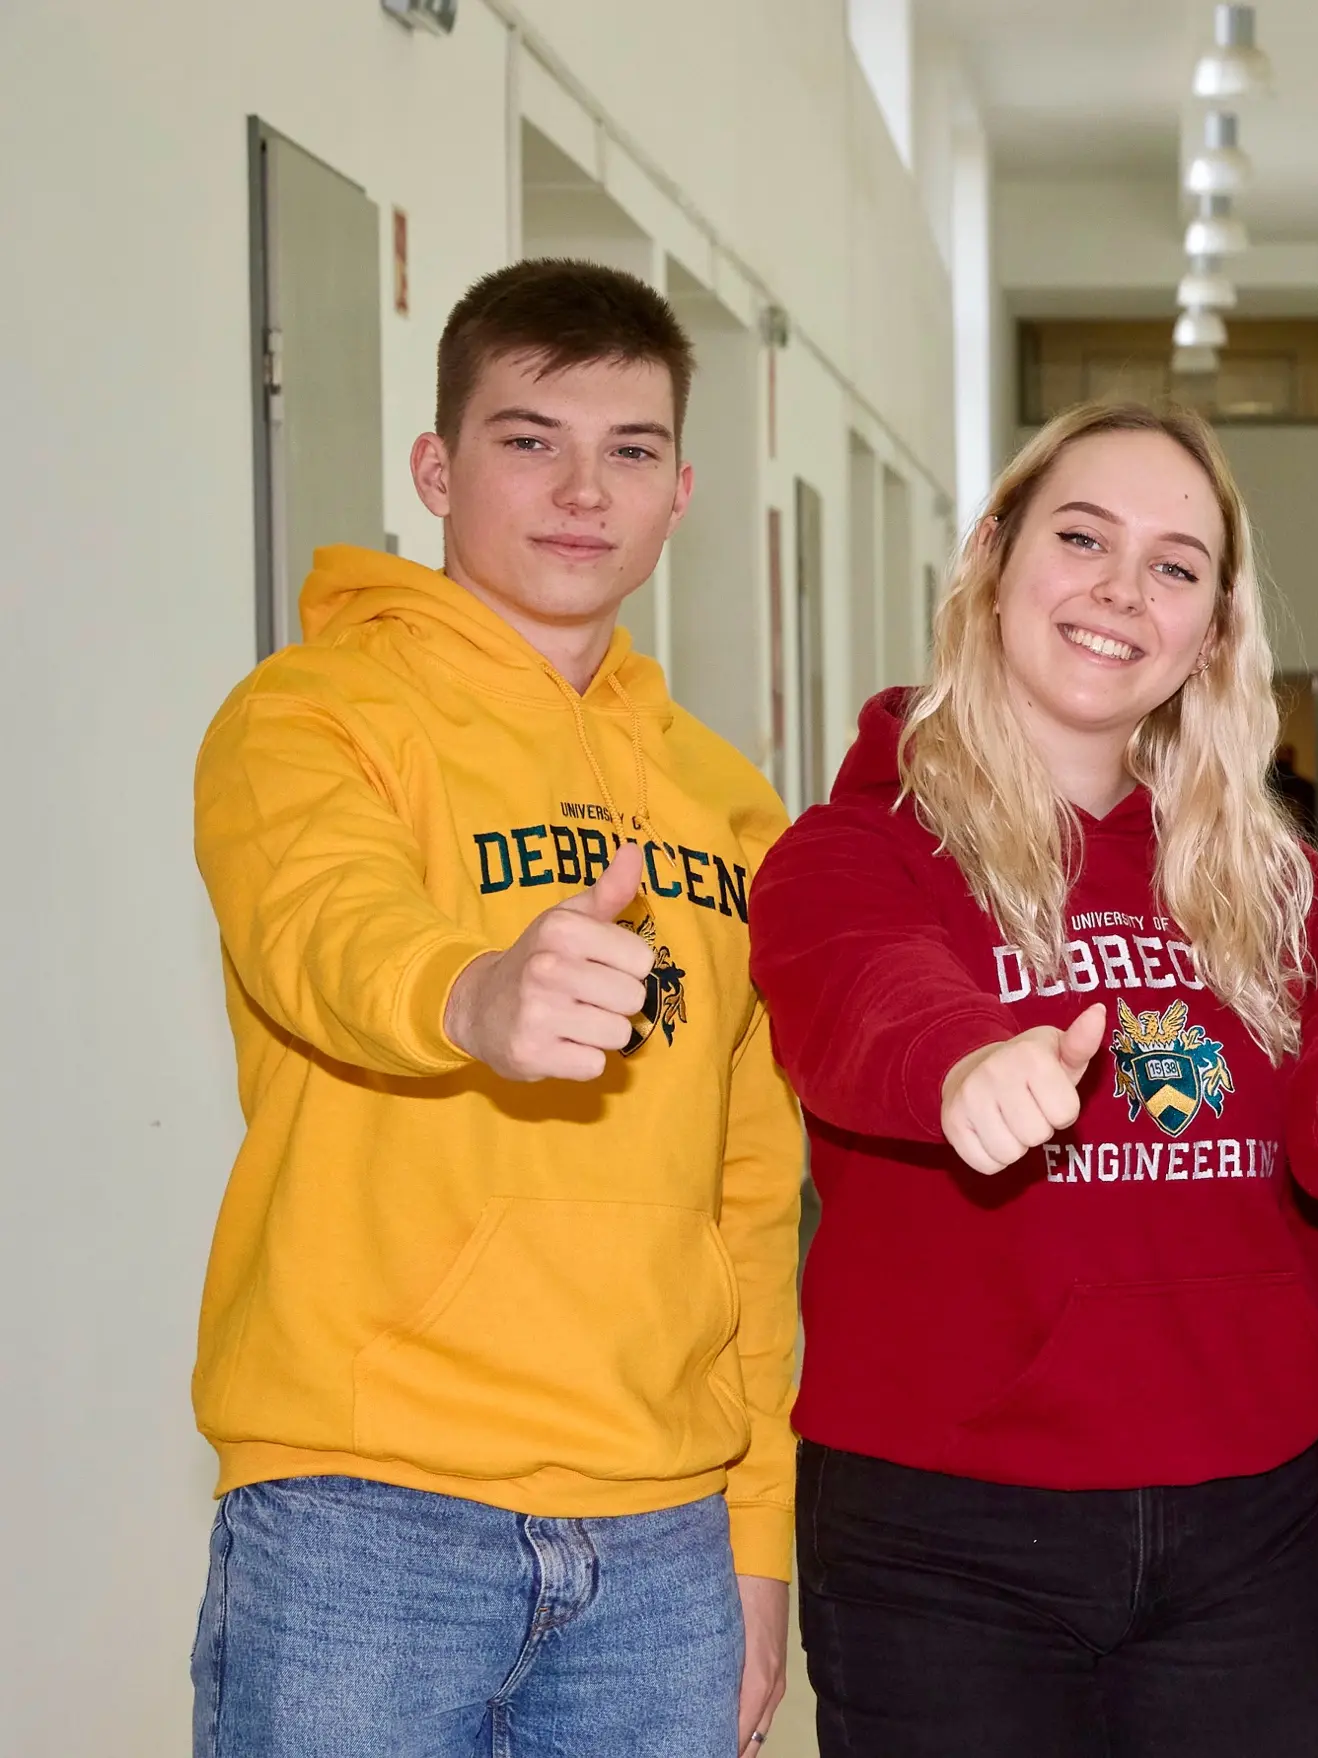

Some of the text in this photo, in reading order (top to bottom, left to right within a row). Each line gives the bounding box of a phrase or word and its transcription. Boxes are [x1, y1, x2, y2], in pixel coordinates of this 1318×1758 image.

[560, 802, 624, 825] UNIVERSY
[473, 824, 749, 925] DEBRCEN
[1071, 911, 1170, 931] UNIVERSITY OF
[992, 934, 1206, 1004] DBREC
[1043, 1138, 1278, 1183] ENGINEERIN
